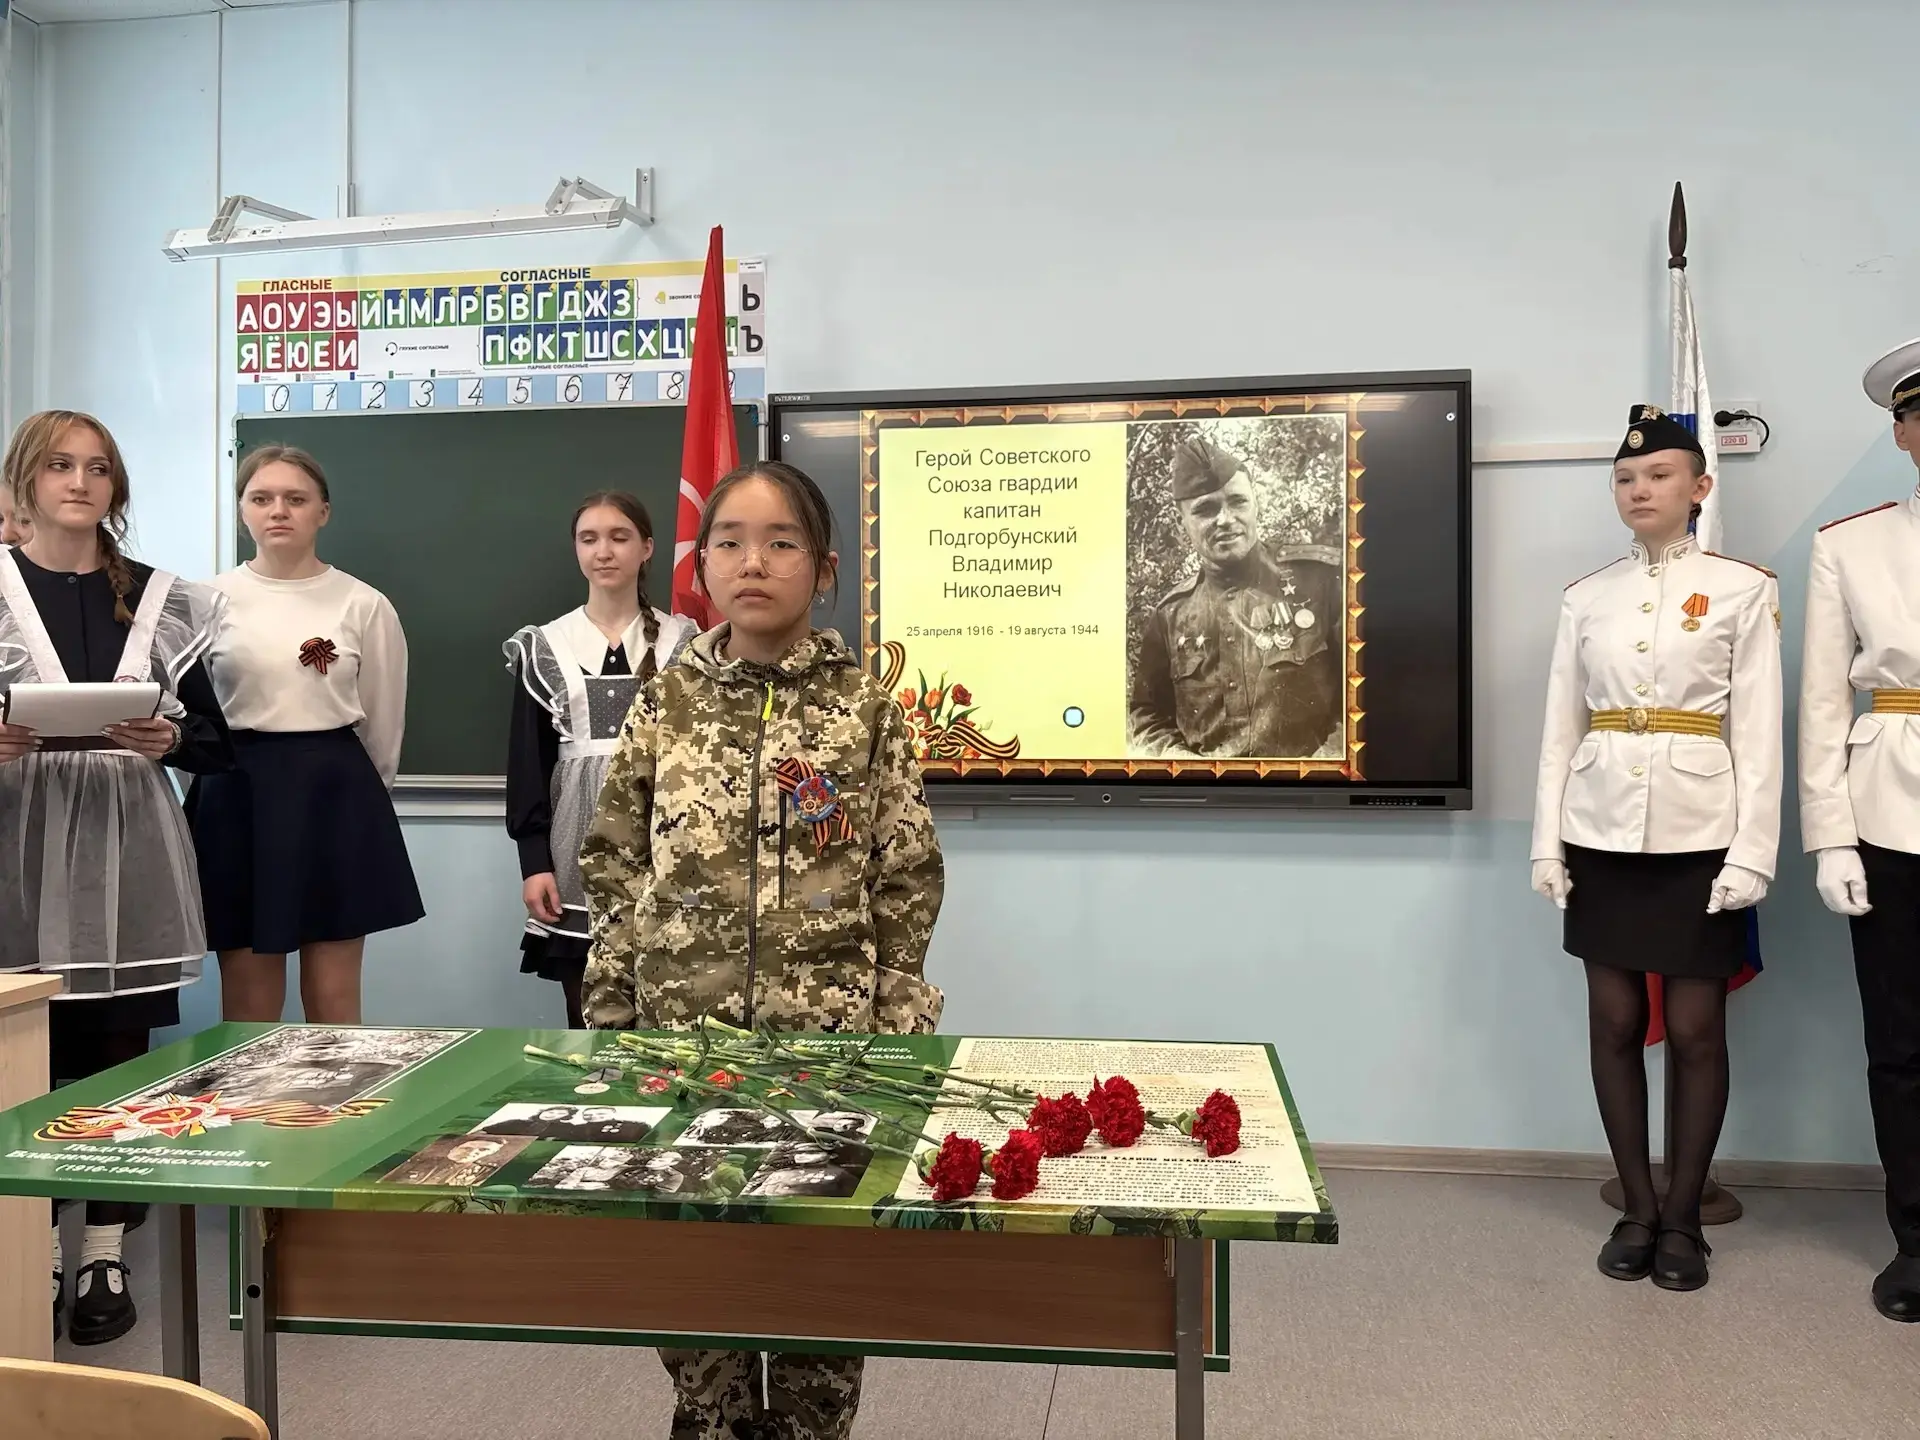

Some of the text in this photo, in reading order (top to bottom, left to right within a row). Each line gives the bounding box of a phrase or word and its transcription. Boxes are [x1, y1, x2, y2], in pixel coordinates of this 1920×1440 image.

[500, 267, 591, 282] СОГЛАСНЫЕ
[262, 279, 332, 292] ГЛАСНЫЕ
[272, 371, 684, 412] 0 1 2 3 4 5 6 7 8
[915, 448, 1091, 471] Герой Советского
[928, 476, 1078, 495] Союза гвардии
[964, 504, 1041, 519] капитан
[929, 526, 1077, 549] Подгорбунский
[952, 555, 1053, 574] Владимир
[944, 582, 1061, 598] Николаевич
[906, 626, 920, 636] 25
[922, 628, 962, 638] апреля
[966, 626, 994, 636] 1916
[1008, 626, 1022, 636] 19
[1024, 626, 1066, 638] августа
[1071, 624, 1099, 635] 1944
[62, 1144, 246, 1157] Подгорбунский
[5, 1150, 272, 1168] Владимир Николаевич
[56, 1164, 154, 1176] (1916-1944)
